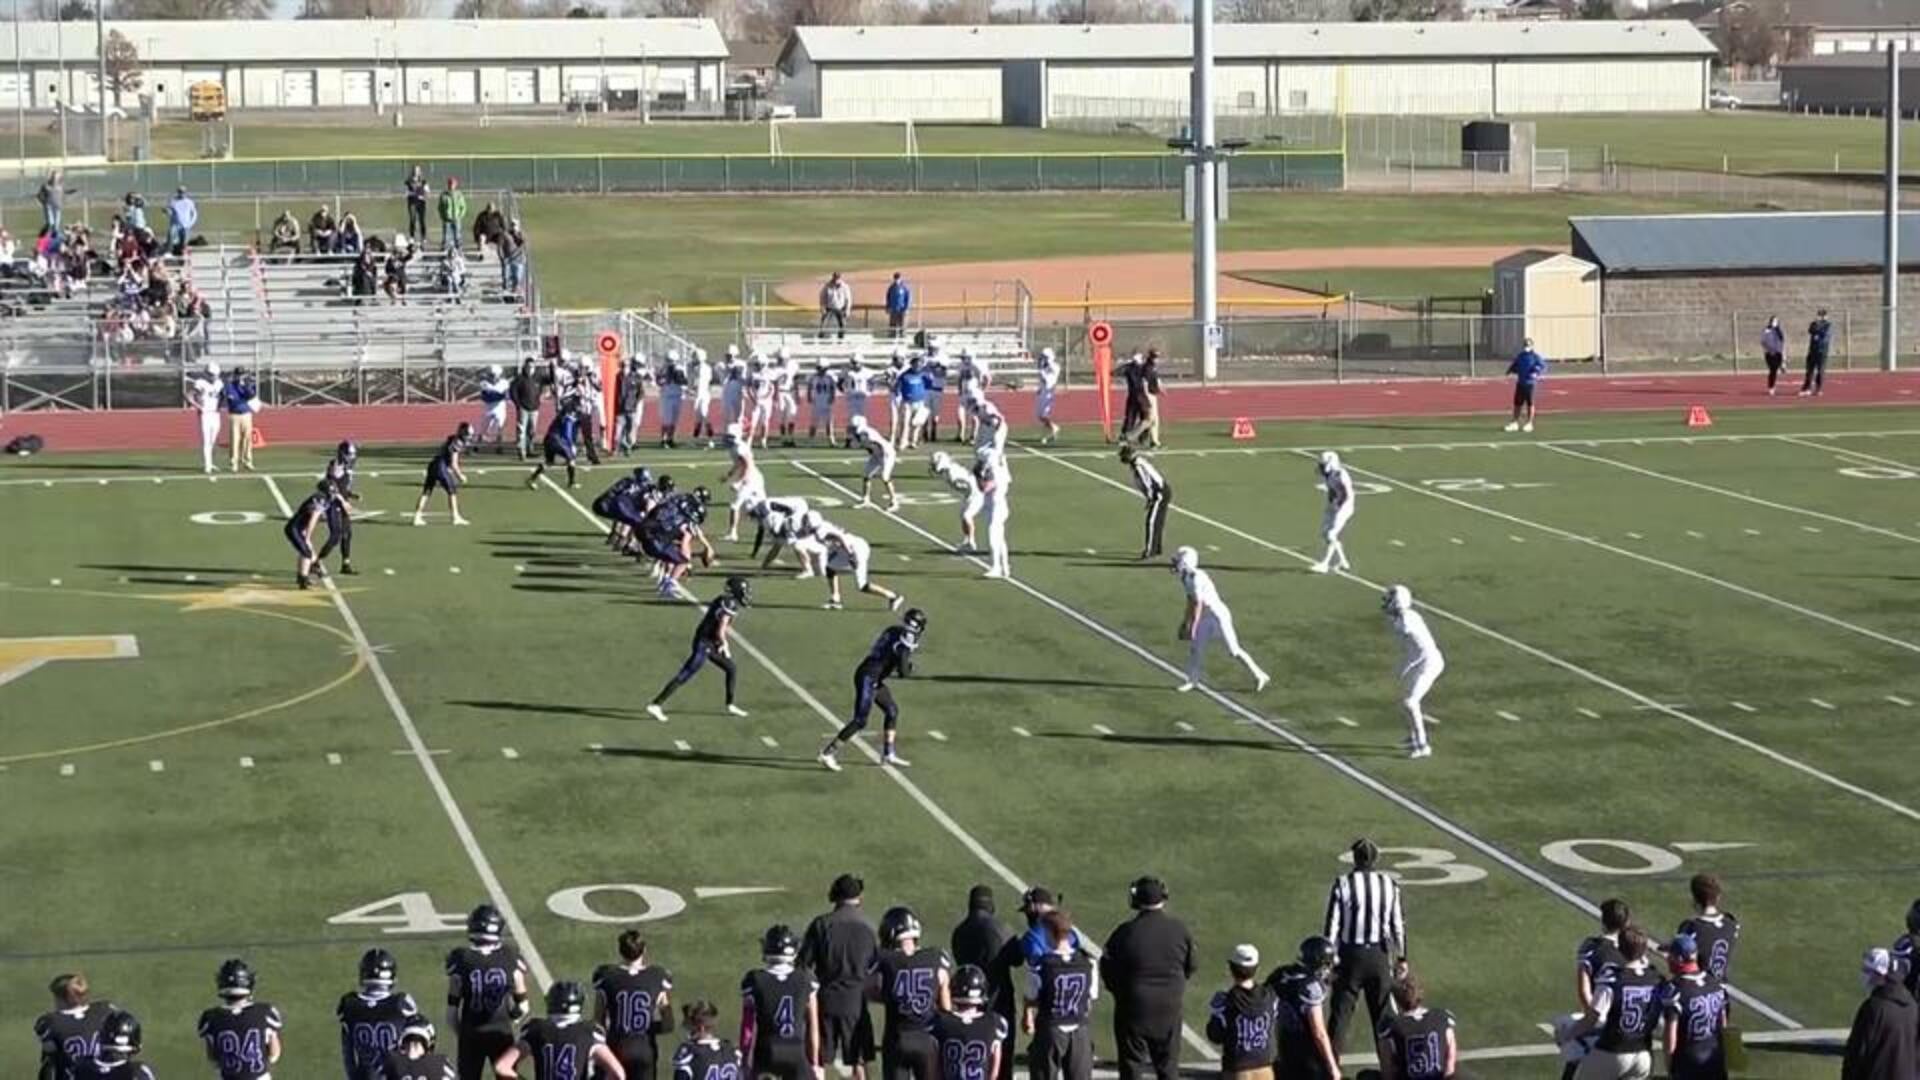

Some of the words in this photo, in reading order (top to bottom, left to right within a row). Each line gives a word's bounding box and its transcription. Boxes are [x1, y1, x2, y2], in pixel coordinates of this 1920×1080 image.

[615, 990, 651, 1035] 16
[893, 967, 934, 1014] 45
[1053, 972, 1086, 1016] 17
[775, 995, 795, 1037] 4
[217, 1027, 263, 1073] 84
[542, 1042, 577, 1080] 14
[1407, 1031, 1441, 1077] 51
